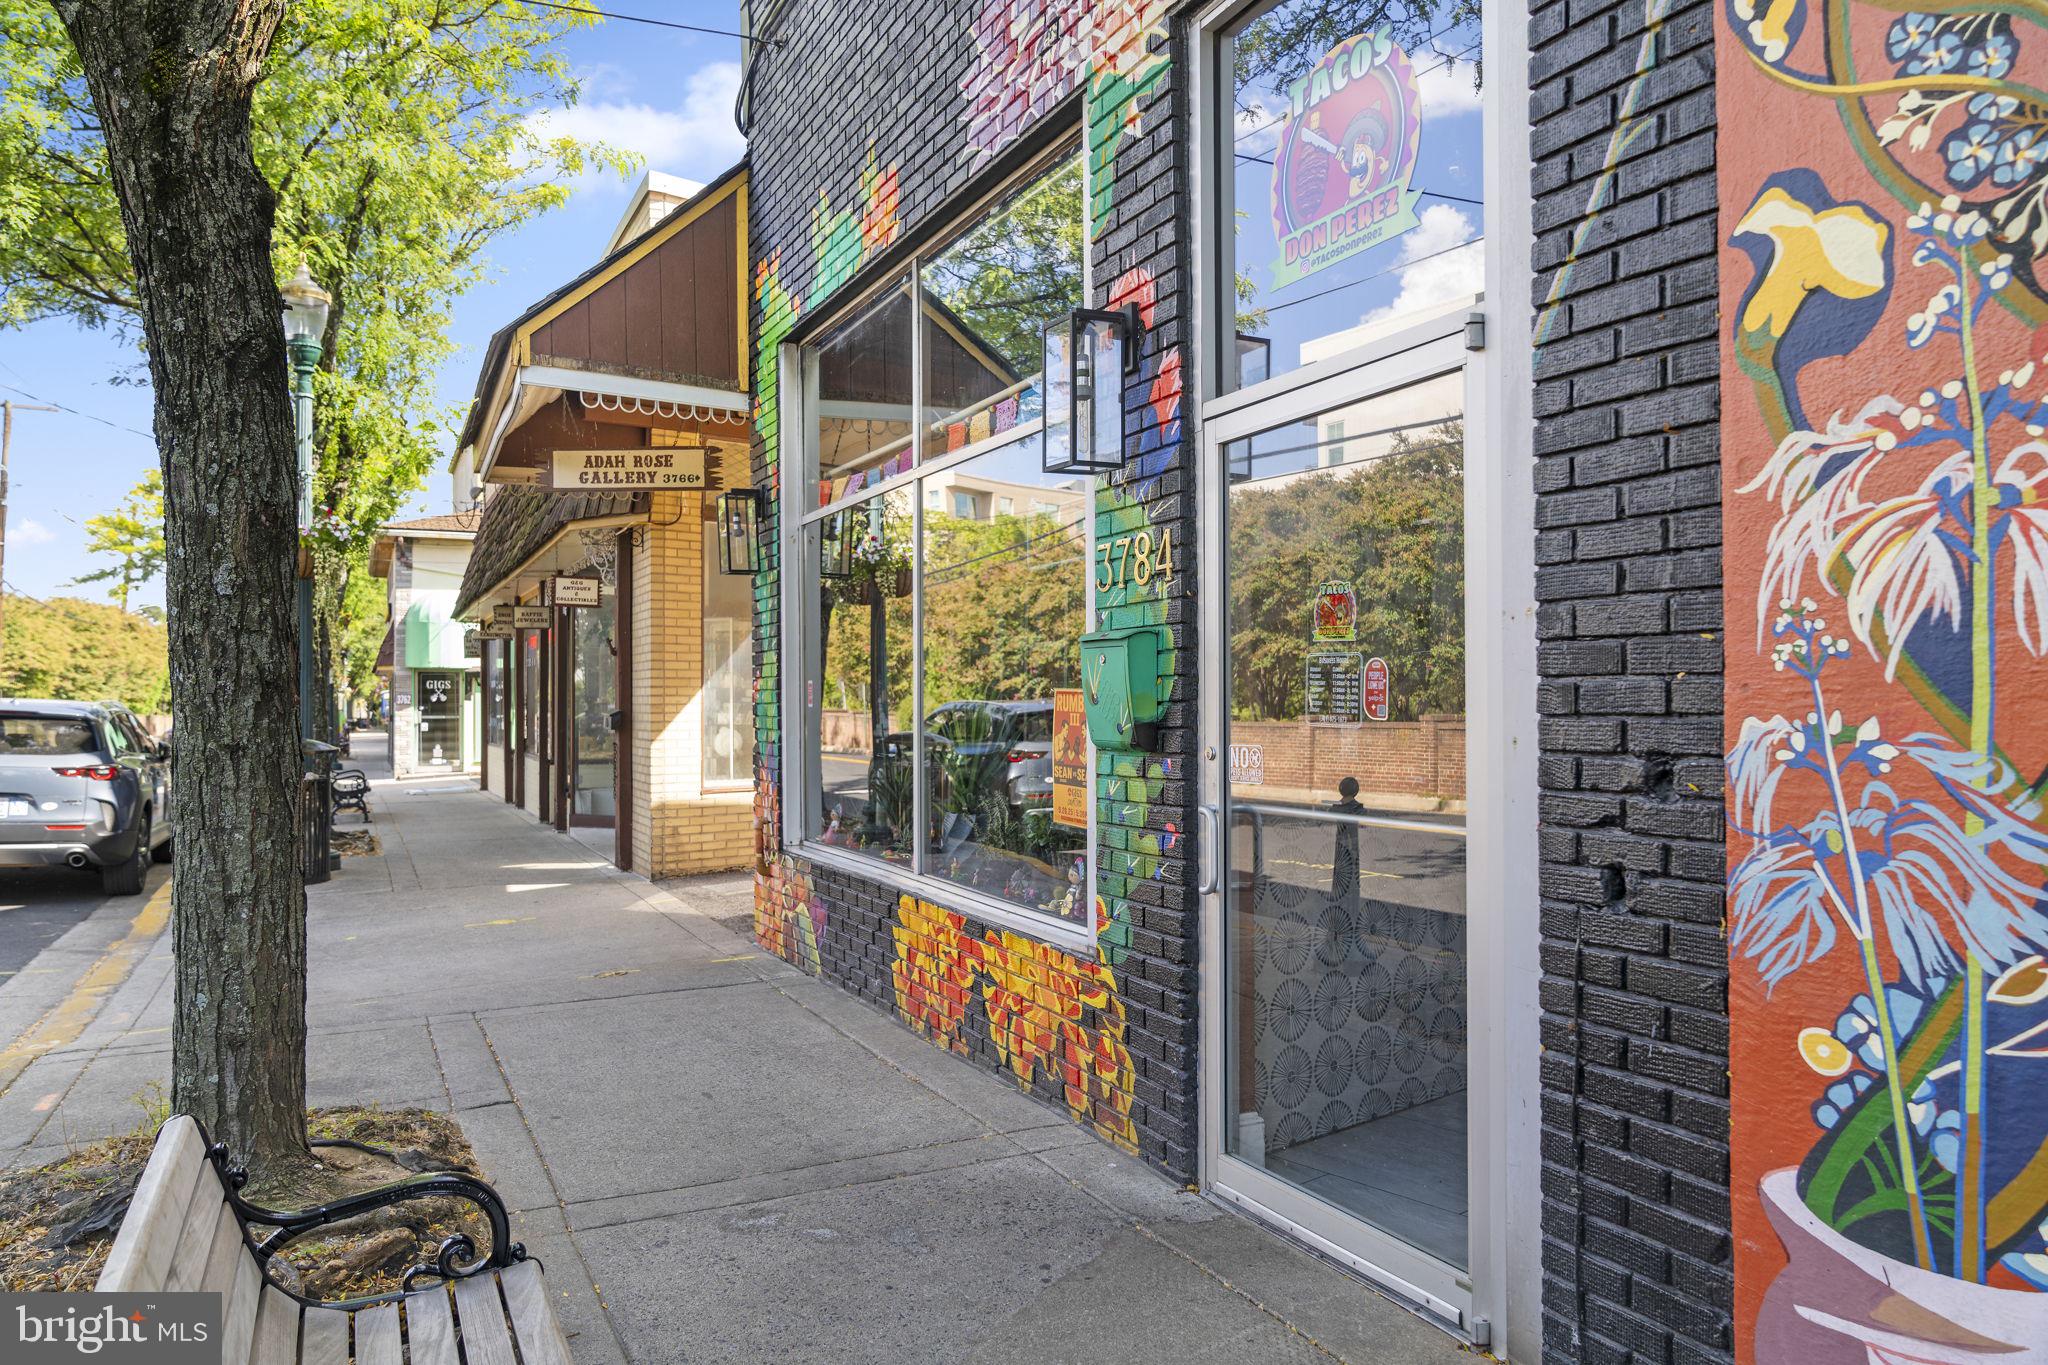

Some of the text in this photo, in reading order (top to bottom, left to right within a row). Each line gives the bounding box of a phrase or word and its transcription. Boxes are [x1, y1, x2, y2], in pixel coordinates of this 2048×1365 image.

[1288, 21, 1393, 117] TACOS
[1285, 185, 1400, 266] DON PEREZ
[584, 454, 673, 468] ADAH ROSE
[579, 471, 694, 484] GALLERY 3766
[1096, 528, 1174, 593] 3784
[1321, 583, 1350, 595] TACOS
[426, 680, 451, 689] GIGS
[1070, 713, 1080, 726] III
[1231, 747, 1249, 768] NO
[1054, 765, 1072, 780] SEAN
